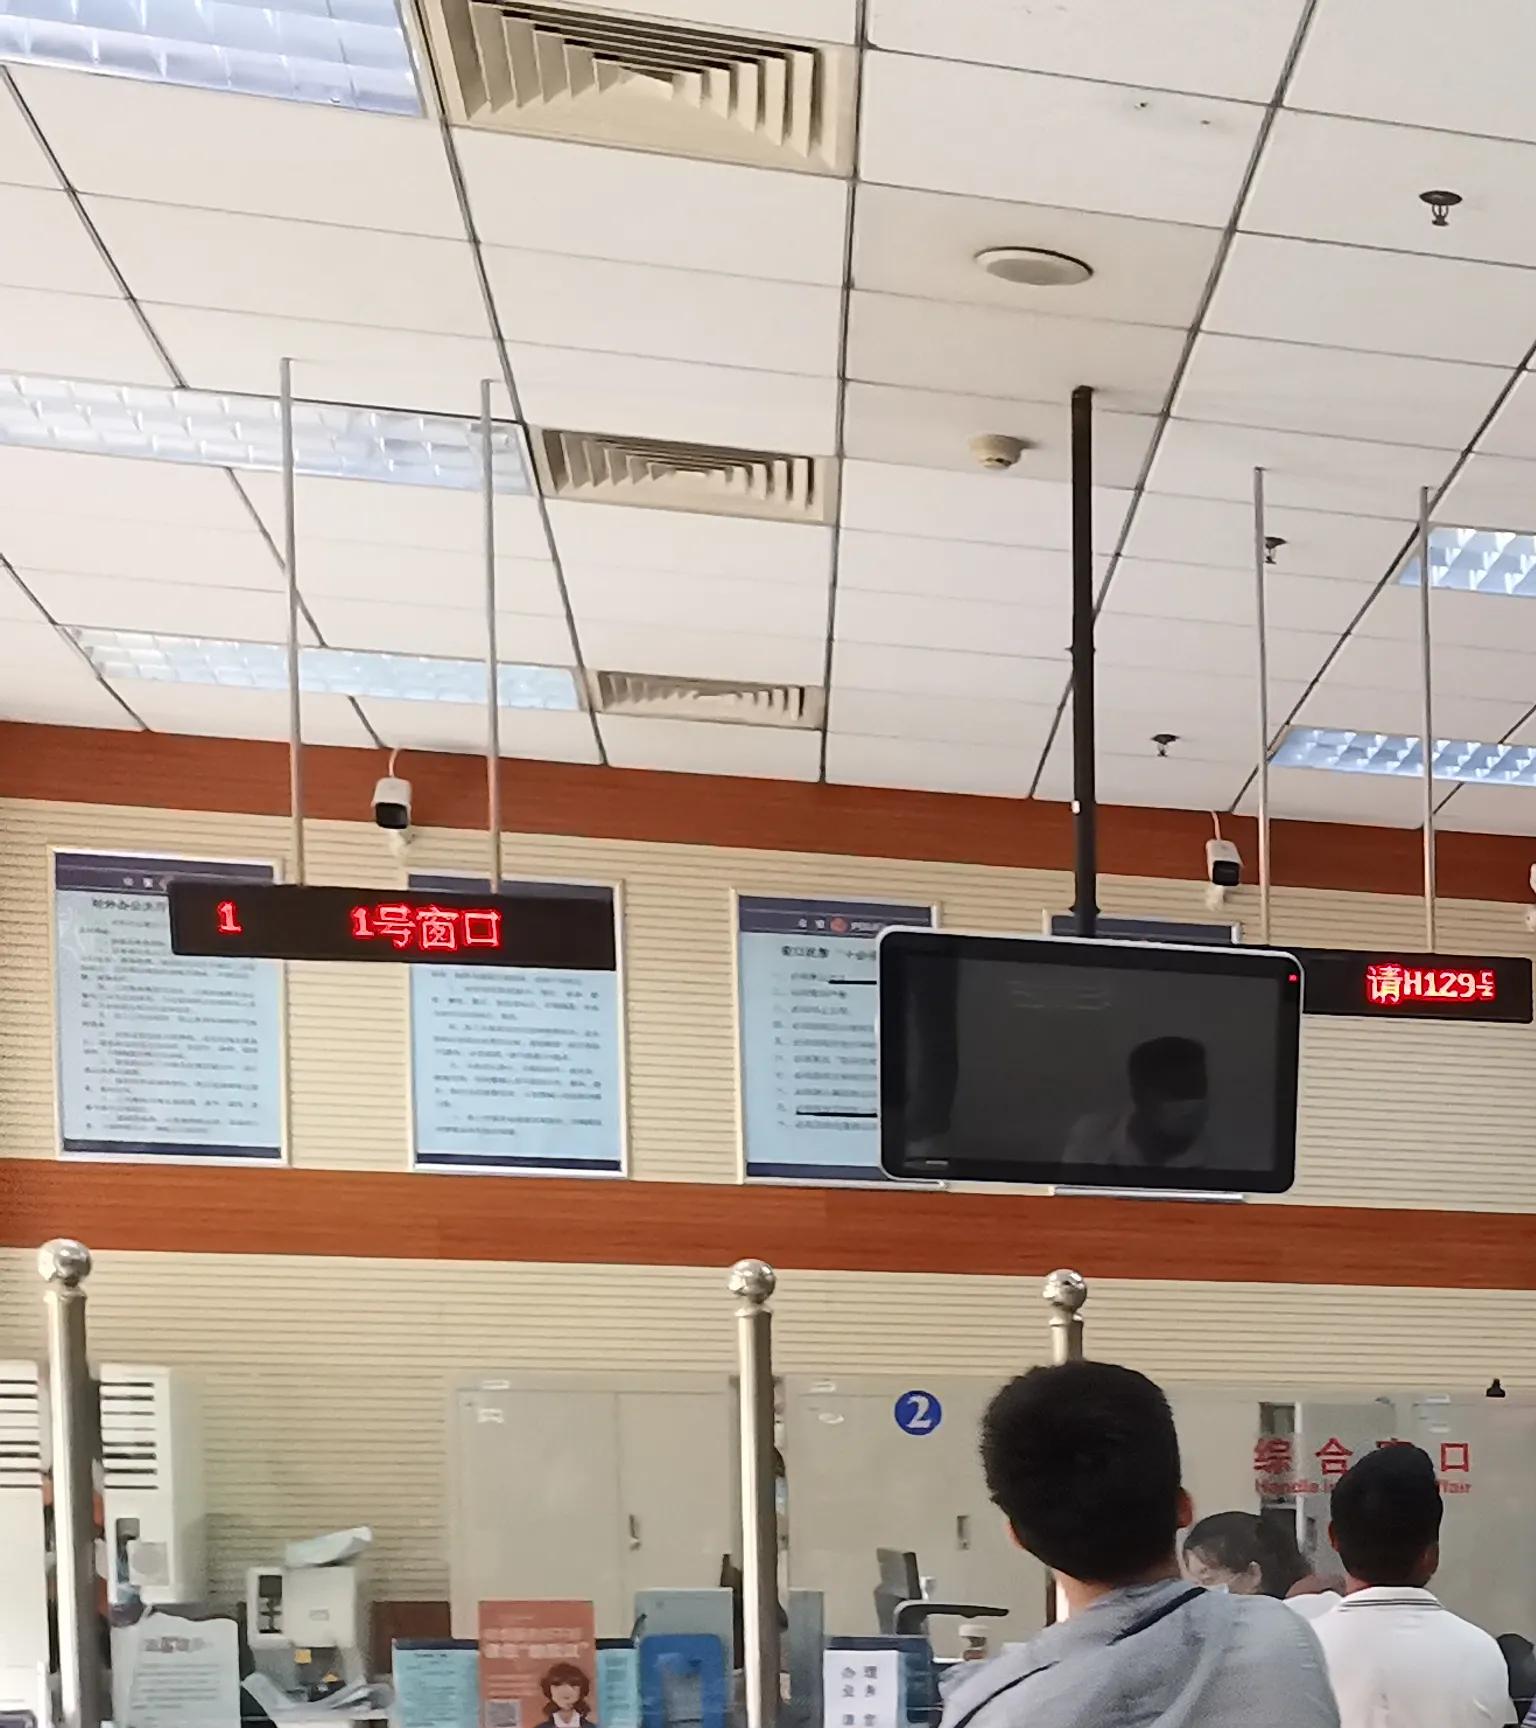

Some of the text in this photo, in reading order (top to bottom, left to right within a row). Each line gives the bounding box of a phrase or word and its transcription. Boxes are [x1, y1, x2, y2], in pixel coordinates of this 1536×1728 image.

[217, 902, 242, 932] 1
[352, 905, 501, 951] 1号窗口
[906, 1394, 933, 1429] 2
[1253, 1437, 1470, 1475] 综合口
